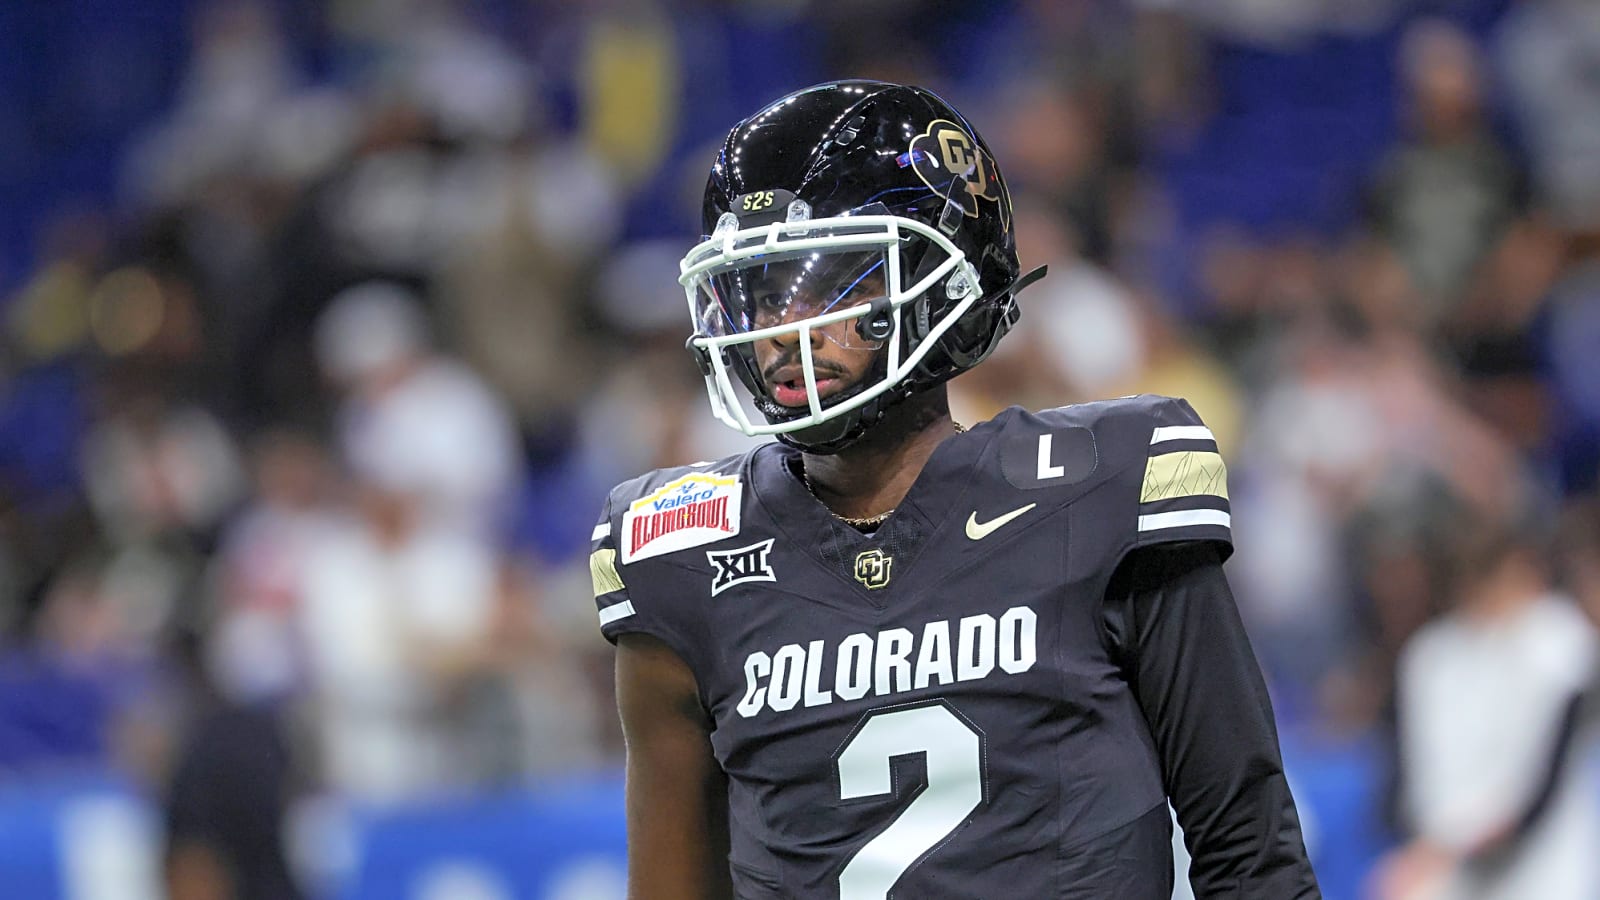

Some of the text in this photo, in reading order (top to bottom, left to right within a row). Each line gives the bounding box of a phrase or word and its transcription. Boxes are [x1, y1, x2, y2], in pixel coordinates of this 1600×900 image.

[742, 190, 774, 211] S2S
[1037, 433, 1065, 480] L
[652, 487, 714, 511] Valero
[709, 541, 773, 592] XII
[736, 605, 1038, 718] COLORADO
[837, 704, 983, 900] 2
